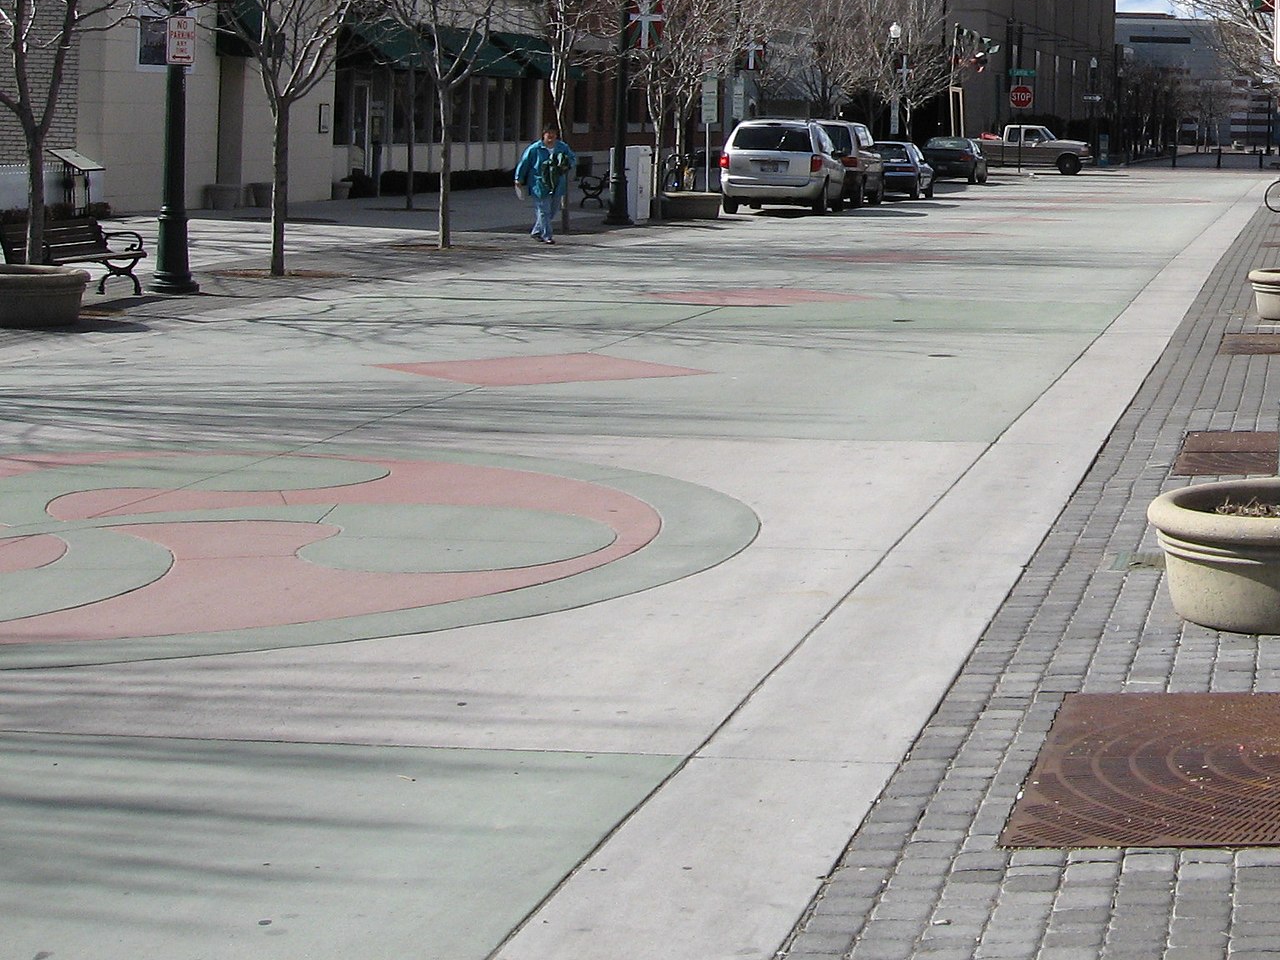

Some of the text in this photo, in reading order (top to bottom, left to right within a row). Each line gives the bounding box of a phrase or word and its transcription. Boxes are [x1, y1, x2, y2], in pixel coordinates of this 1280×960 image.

[177, 19, 188, 30] NO
[170, 31, 194, 40] PARKING
[1011, 92, 1031, 101] STOP
